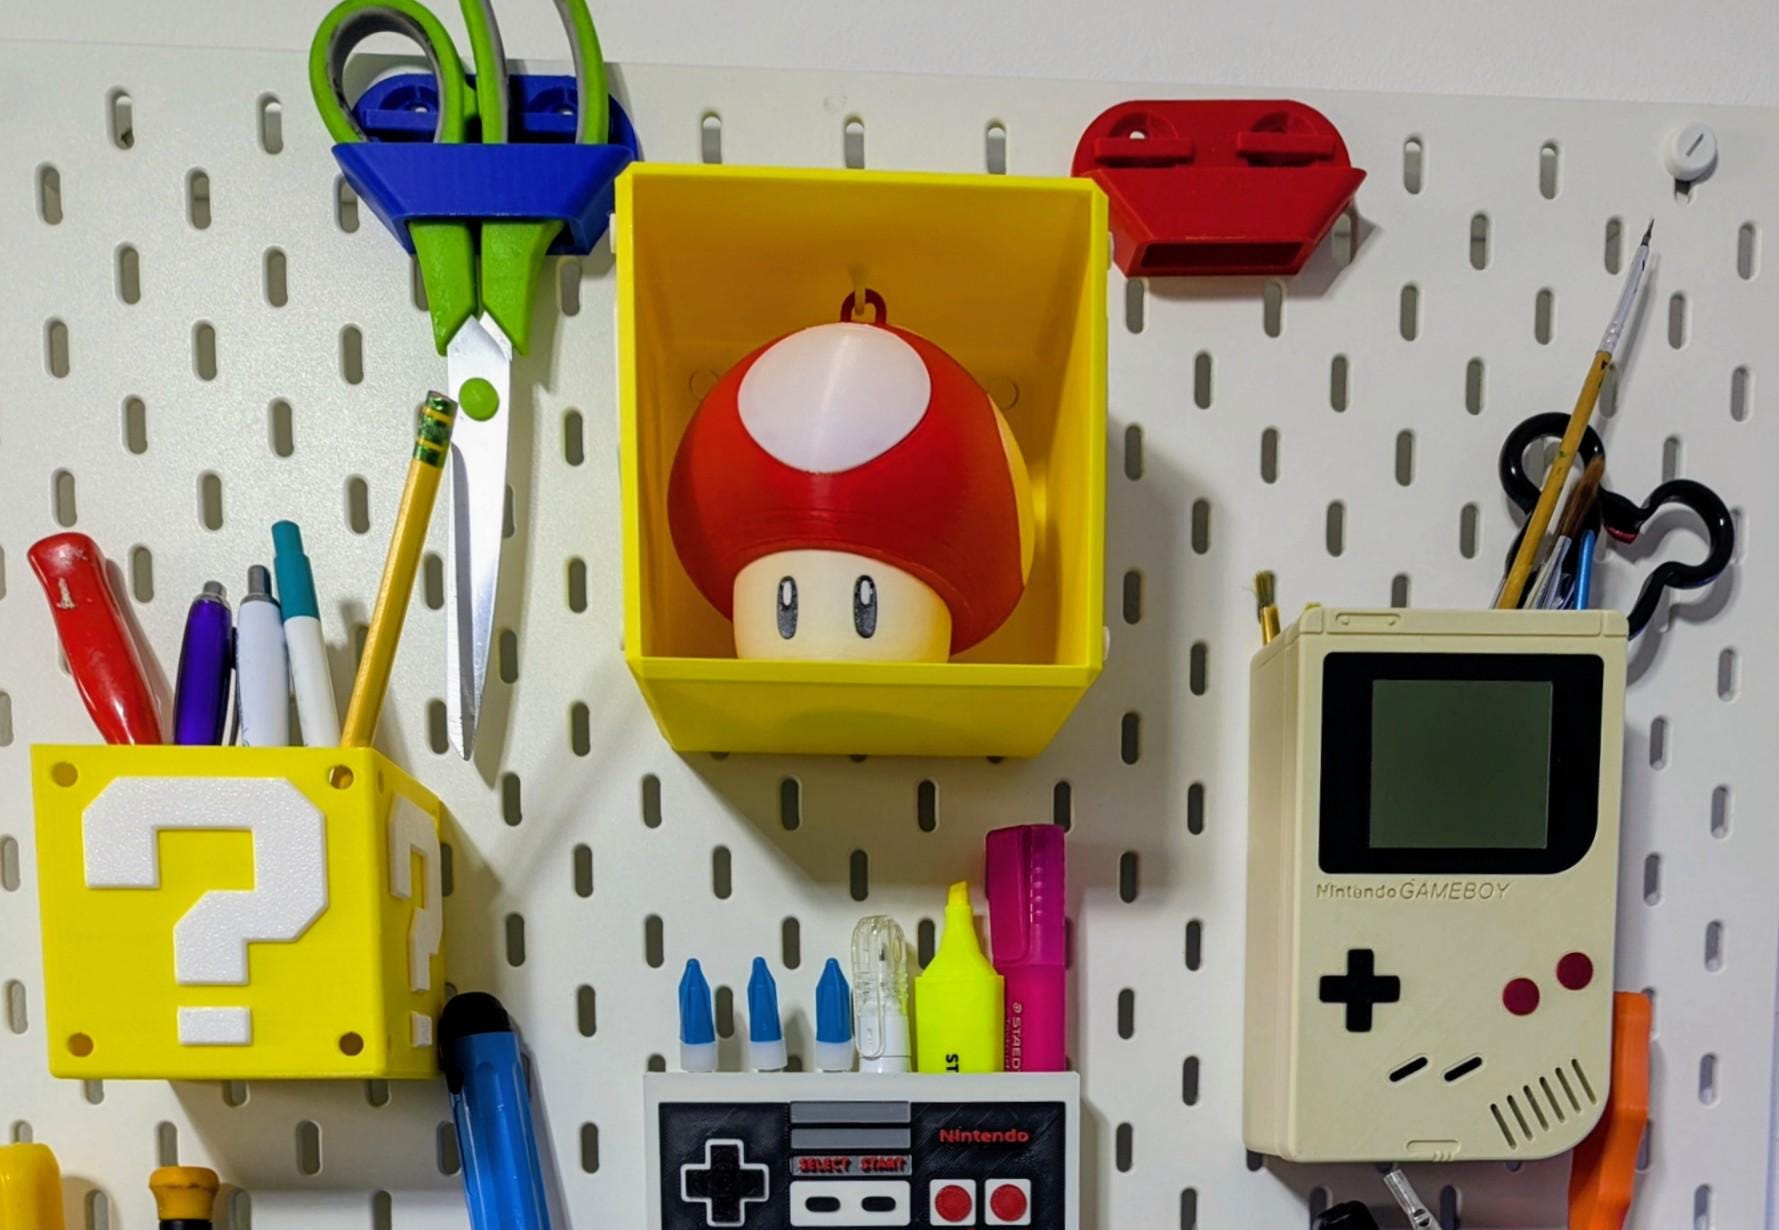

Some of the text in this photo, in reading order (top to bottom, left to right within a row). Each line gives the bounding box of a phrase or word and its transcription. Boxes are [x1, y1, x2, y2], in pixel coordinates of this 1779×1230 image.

[1315, 881, 1511, 900] Nintendo GAMEBOY
[1011, 1016, 1022, 1072] STAED
[938, 1128, 1030, 1144] Nintendo
[798, 1155, 907, 1173] SELECT START
